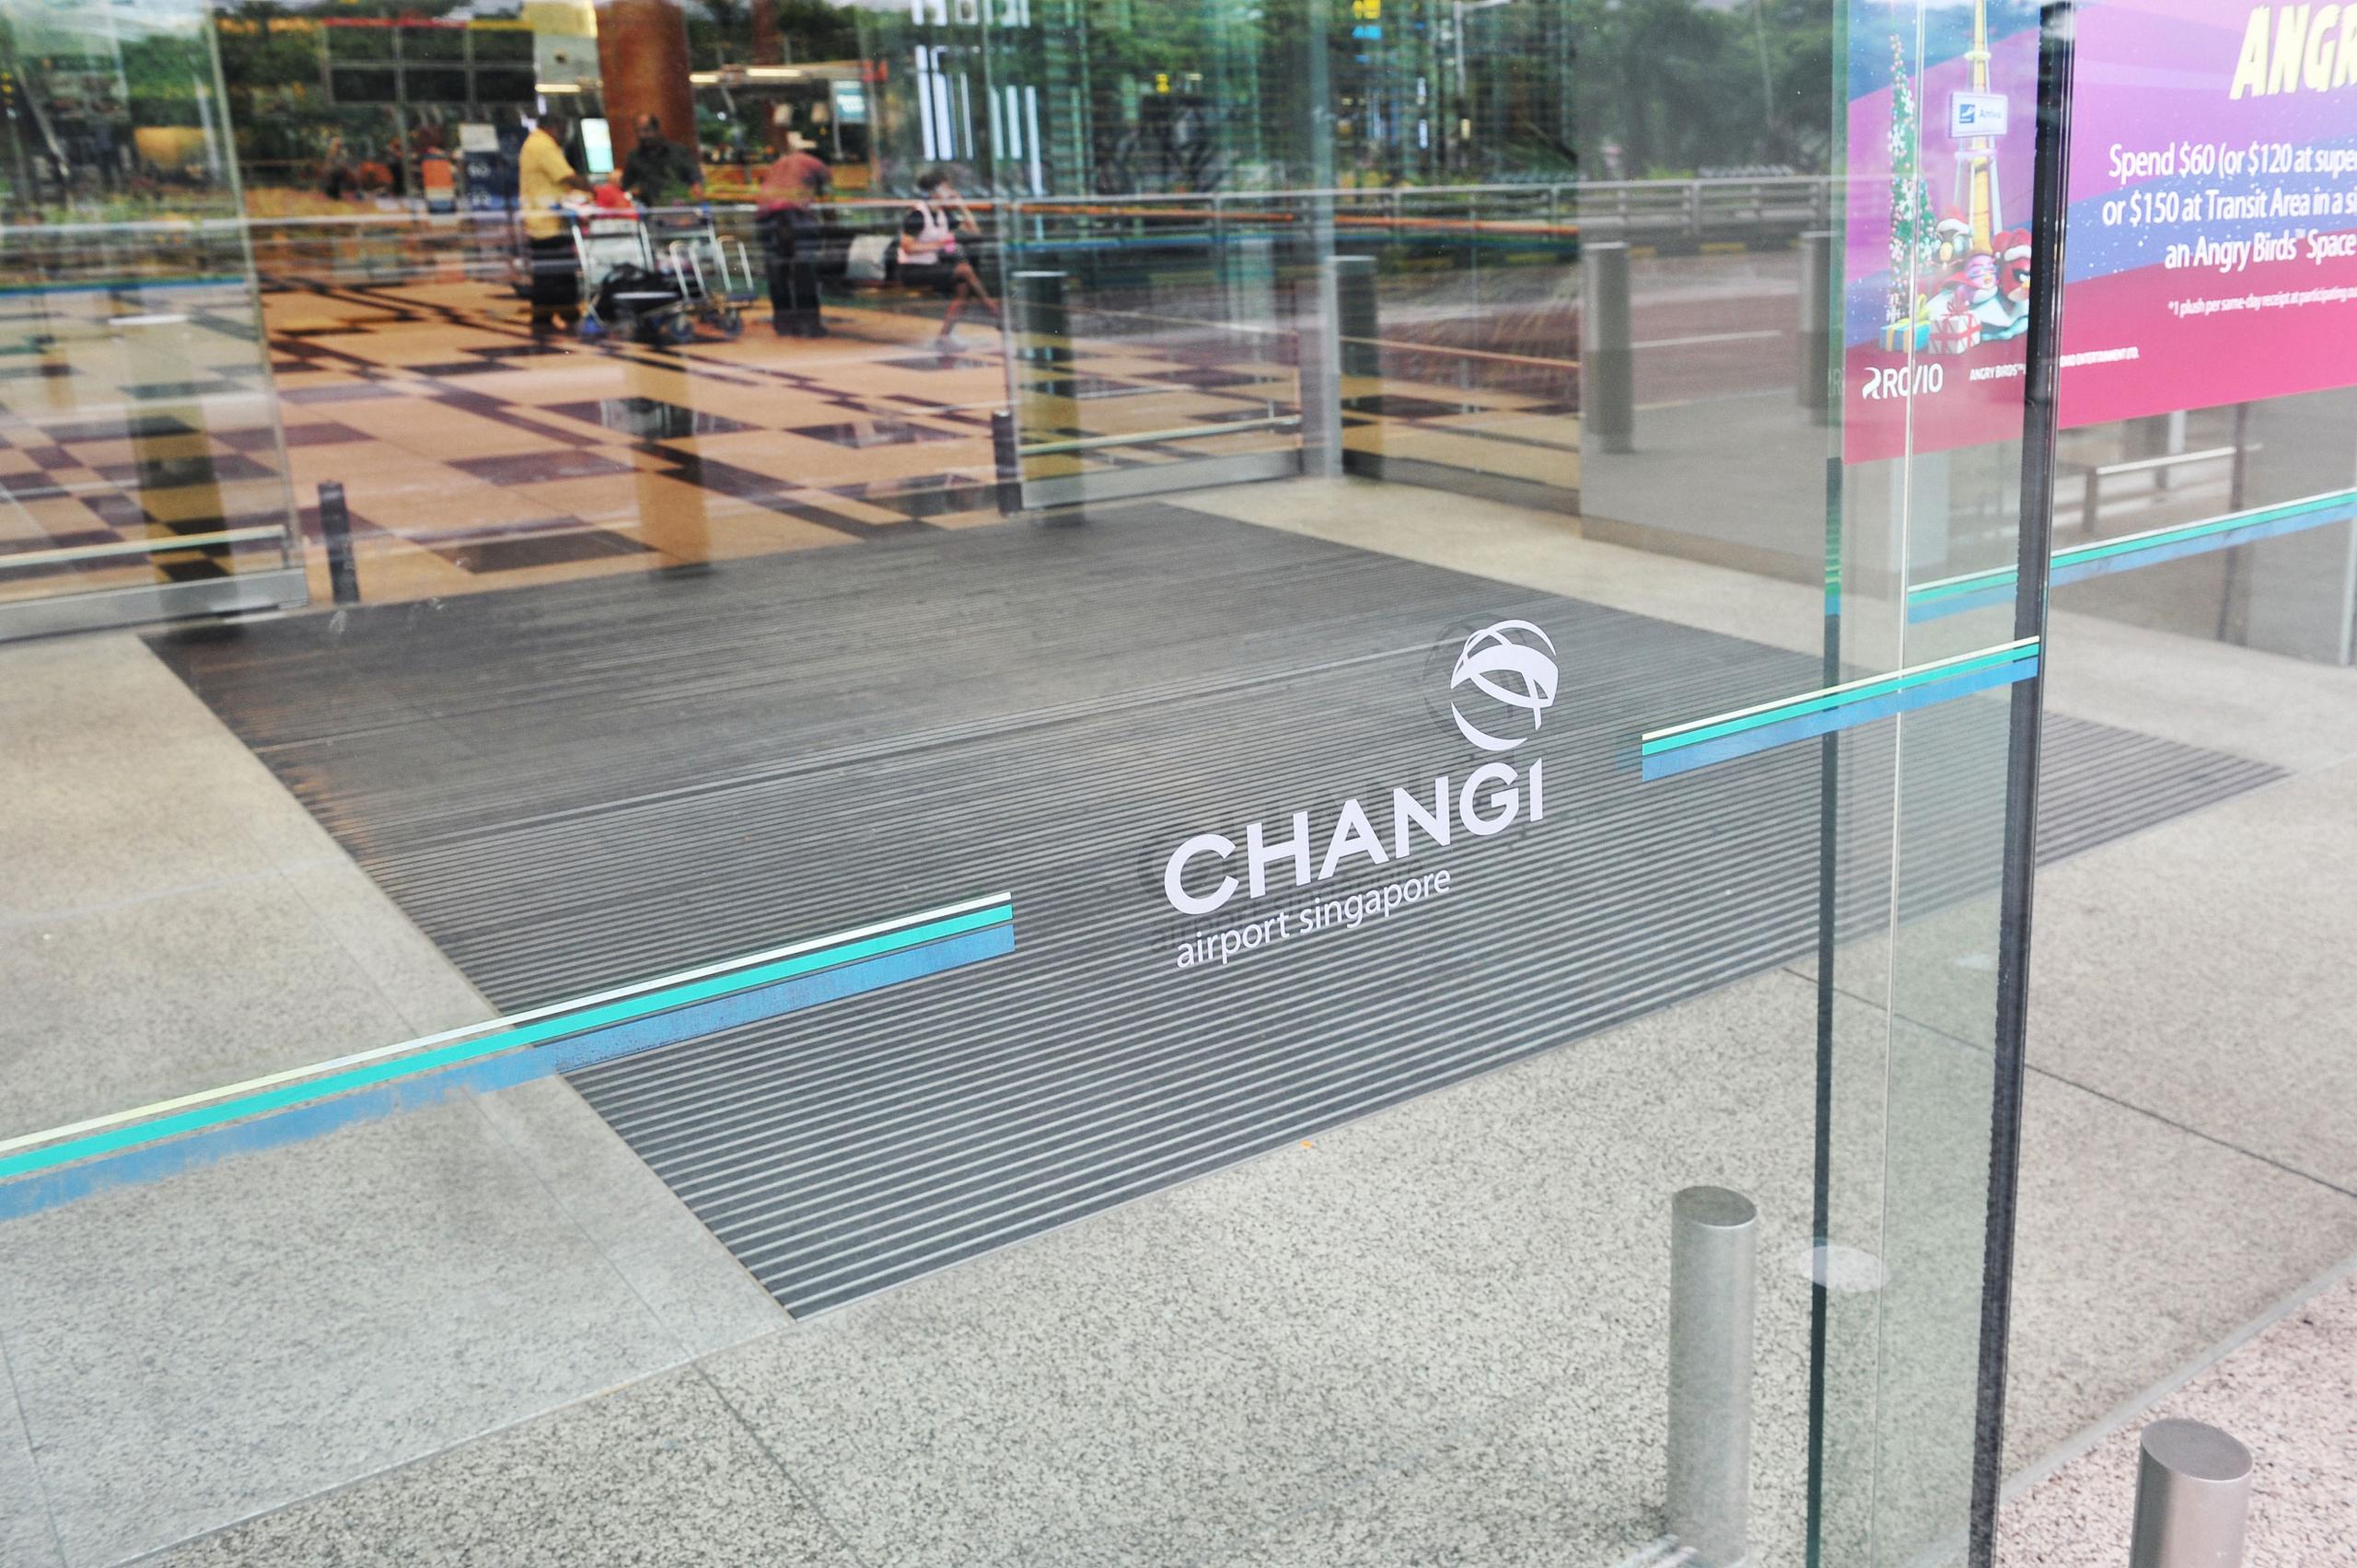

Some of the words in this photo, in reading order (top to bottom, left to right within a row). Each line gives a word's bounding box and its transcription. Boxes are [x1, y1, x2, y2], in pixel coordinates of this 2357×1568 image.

[2107, 142, 2177, 185] Spend
[2178, 141, 2216, 179] $60
[2217, 142, 2247, 180] (or
[2247, 139, 2293, 177] $120
[2293, 145, 2315, 173] at
[2101, 199, 2127, 226] or
[2129, 189, 2180, 227] $150
[2181, 193, 2202, 222] at
[2204, 187, 2269, 221] Transit
[2269, 186, 2311, 218] Area
[2312, 185, 2330, 216] in
[2331, 192, 2344, 215] a
[2165, 242, 2190, 270] an
[2192, 235, 2252, 273] Angry
[2305, 227, 2357, 266] Space
[2178, 296, 2205, 319] plush
[2204, 299, 2221, 317] per
[1968, 366, 1994, 382] ANGRY
[1165, 757, 1543, 915] CHANGI
[1177, 910, 1290, 968] airport
[1299, 868, 1452, 934] singapore
